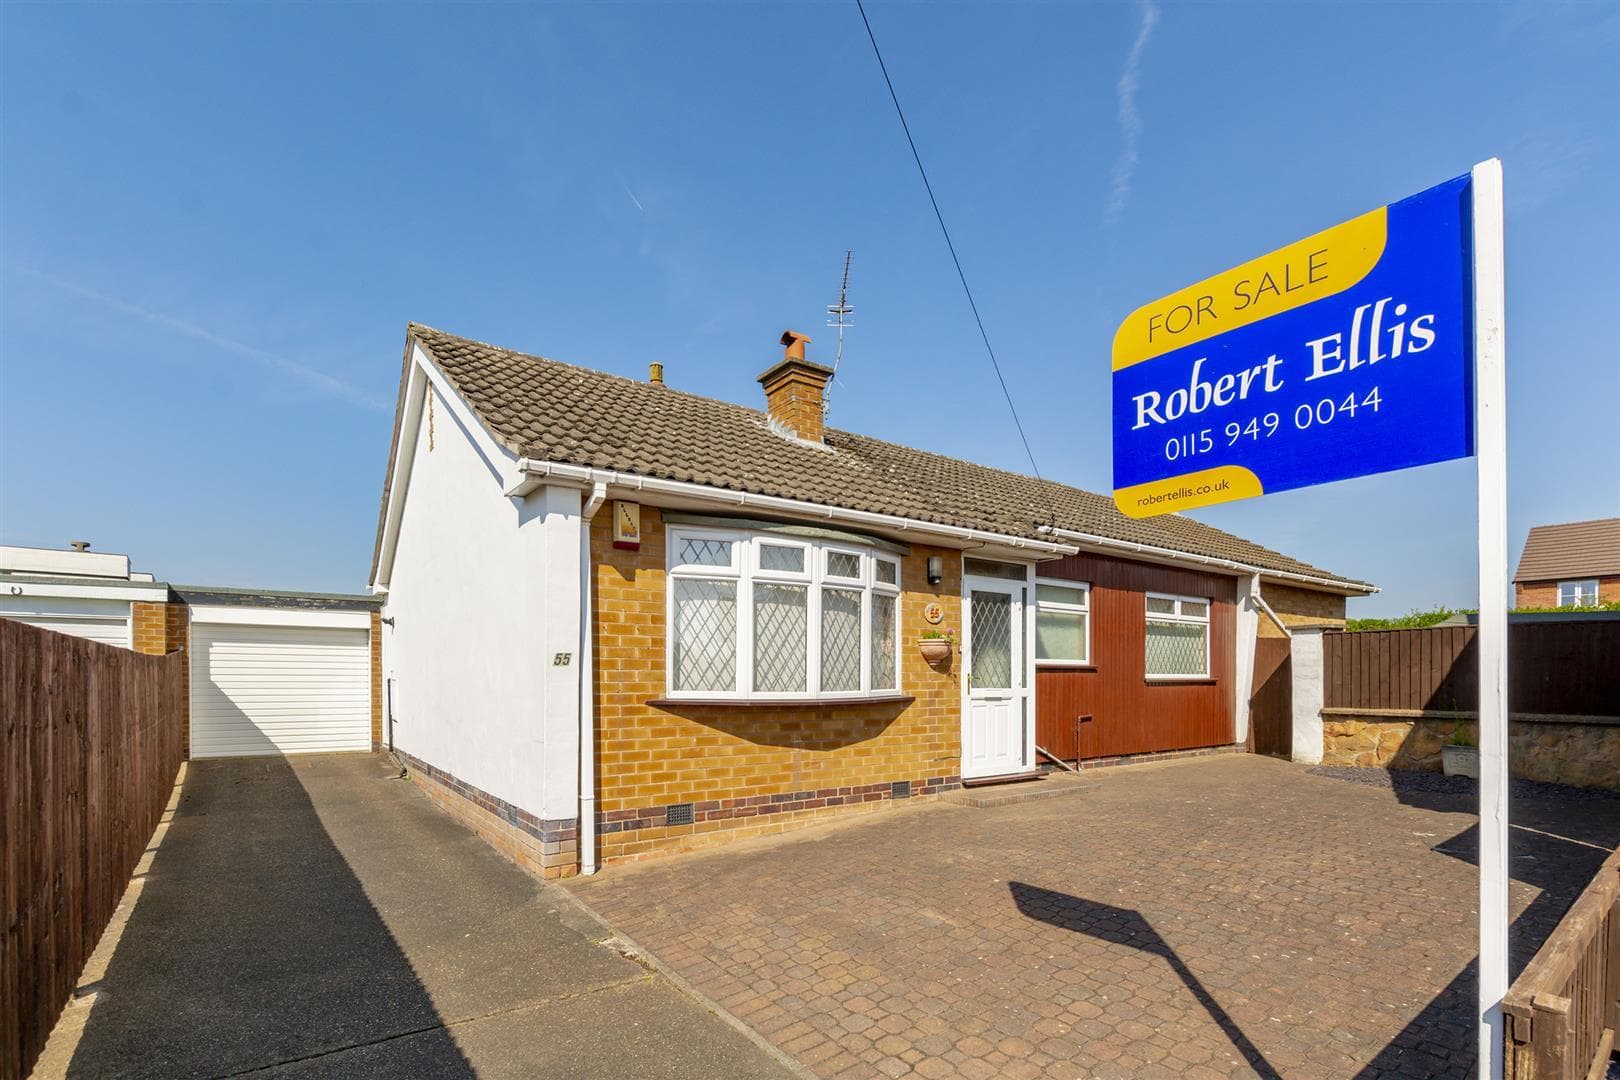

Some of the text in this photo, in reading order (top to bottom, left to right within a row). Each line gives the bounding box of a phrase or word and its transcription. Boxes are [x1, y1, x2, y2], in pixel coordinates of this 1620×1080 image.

[1148, 248, 1330, 344] FOR SALE
[1131, 296, 1437, 431] Robert Ellis
[1164, 386, 1383, 462] 0115 949 0044
[1136, 478, 1230, 508] robertellis.co.uk
[553, 652, 572, 666] 55
